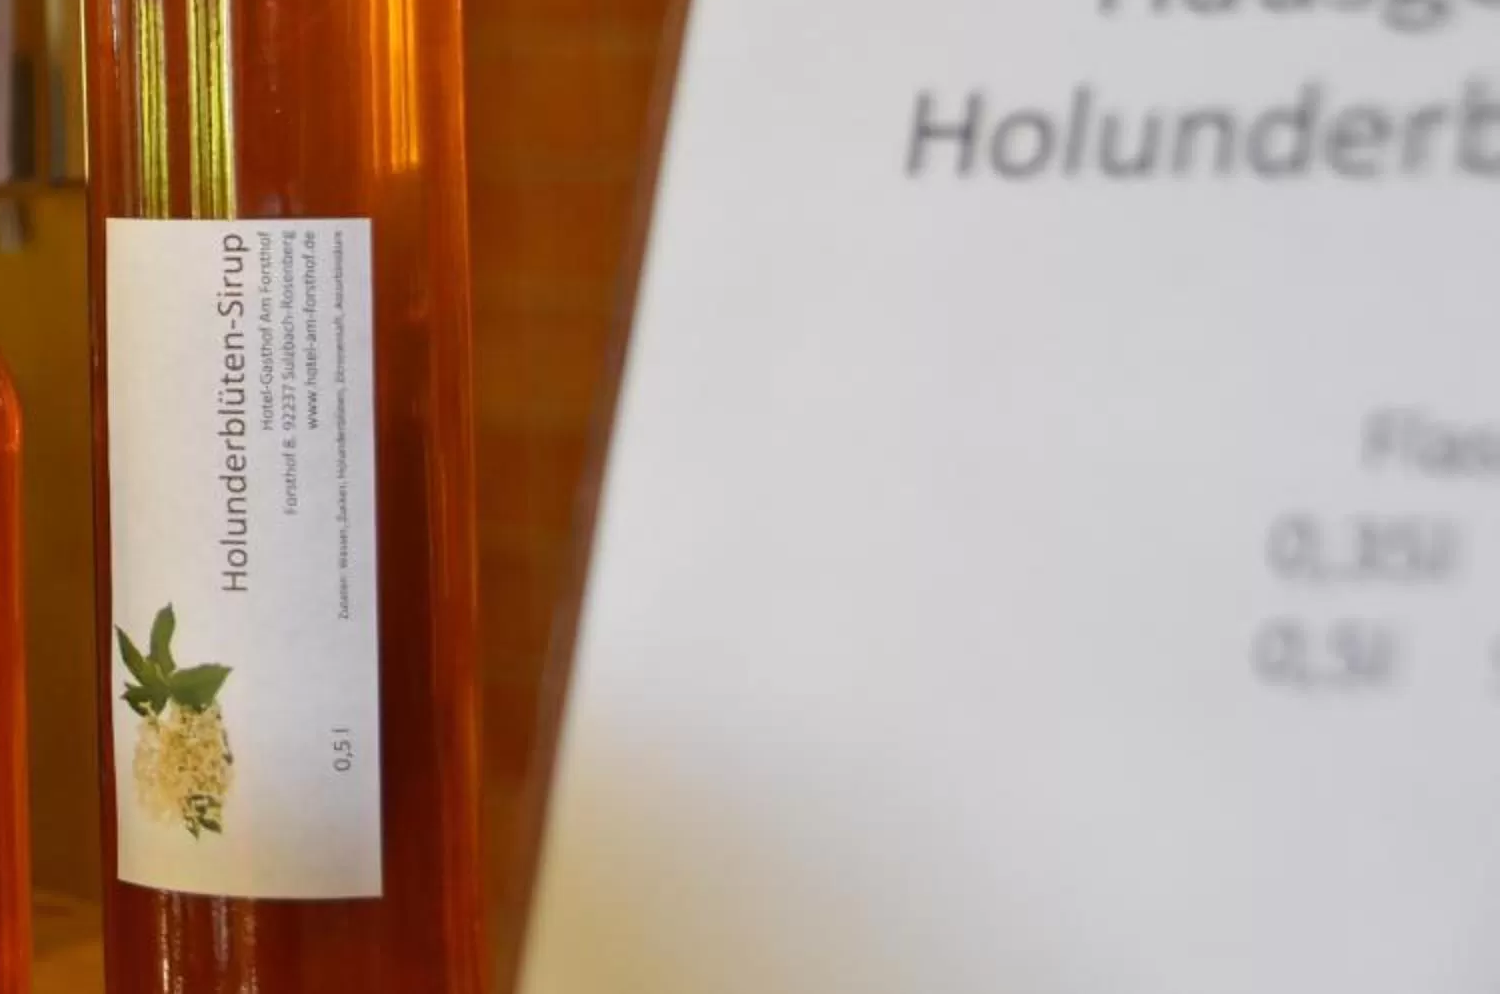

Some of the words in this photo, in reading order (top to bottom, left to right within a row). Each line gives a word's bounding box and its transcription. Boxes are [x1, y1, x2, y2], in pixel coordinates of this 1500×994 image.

[256, 231, 272, 293] Forsthof
[258, 297, 272, 323] Am
[280, 230, 296, 380] Sulzbach-Rosenberg
[301, 230, 318, 430] www.hotel-am-forsthof.de
[257, 327, 274, 431] Hotel-Gasthof
[280, 384, 296, 431] 92237
[216, 232, 249, 592] Holunderblüten-Sirup
[281, 453, 297, 515] Forsthof
[332, 740, 354, 772] 0,5
